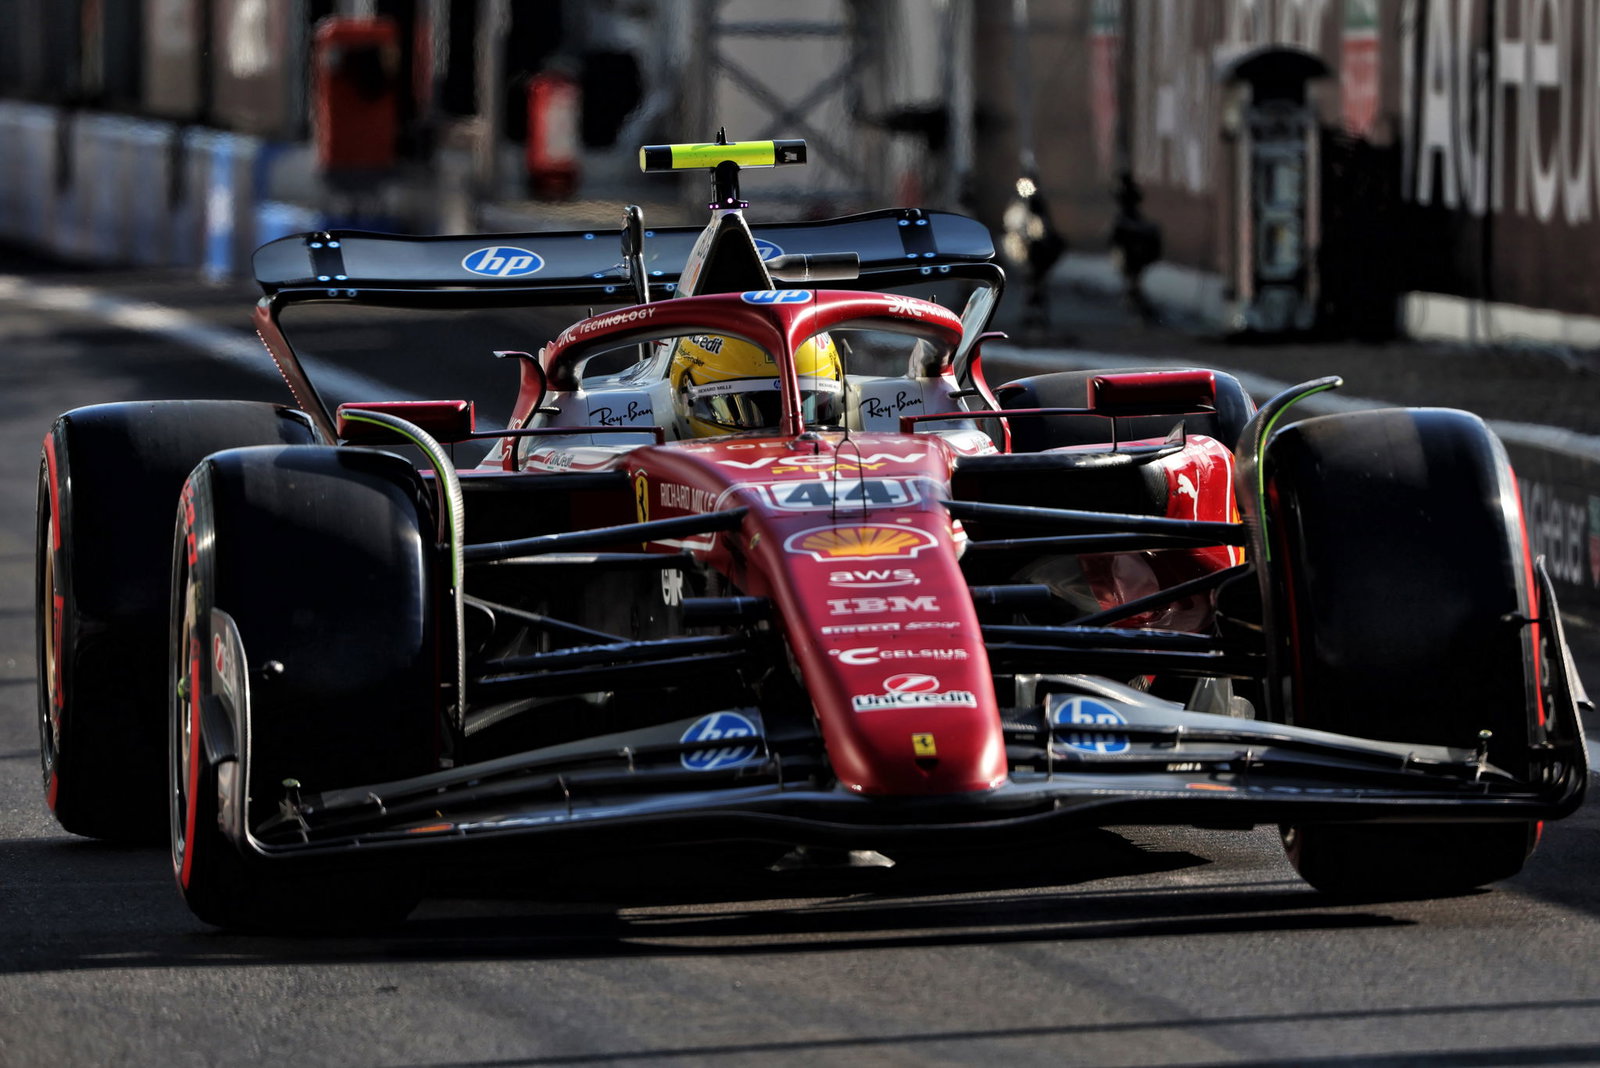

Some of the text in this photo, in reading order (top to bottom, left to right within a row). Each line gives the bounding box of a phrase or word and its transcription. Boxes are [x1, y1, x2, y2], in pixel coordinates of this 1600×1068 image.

[475, 247, 534, 277] hp
[580, 306, 656, 335] TECHNOLOGY
[590, 401, 653, 426] Ray-Ban
[860, 391, 923, 418] Ray-Ban
[716, 453, 927, 469] VGW
[771, 462, 887, 475] PLAY
[660, 483, 717, 514] RICHARD MILLE
[785, 480, 899, 506] 44
[829, 569, 915, 582] aws
[827, 596, 940, 615] IBM
[821, 622, 900, 634] PIRELLI
[880, 648, 967, 660] CELSIUS
[855, 691, 972, 707] UniCredit
[1071, 697, 1118, 753] hp
[690, 712, 749, 769] hp
